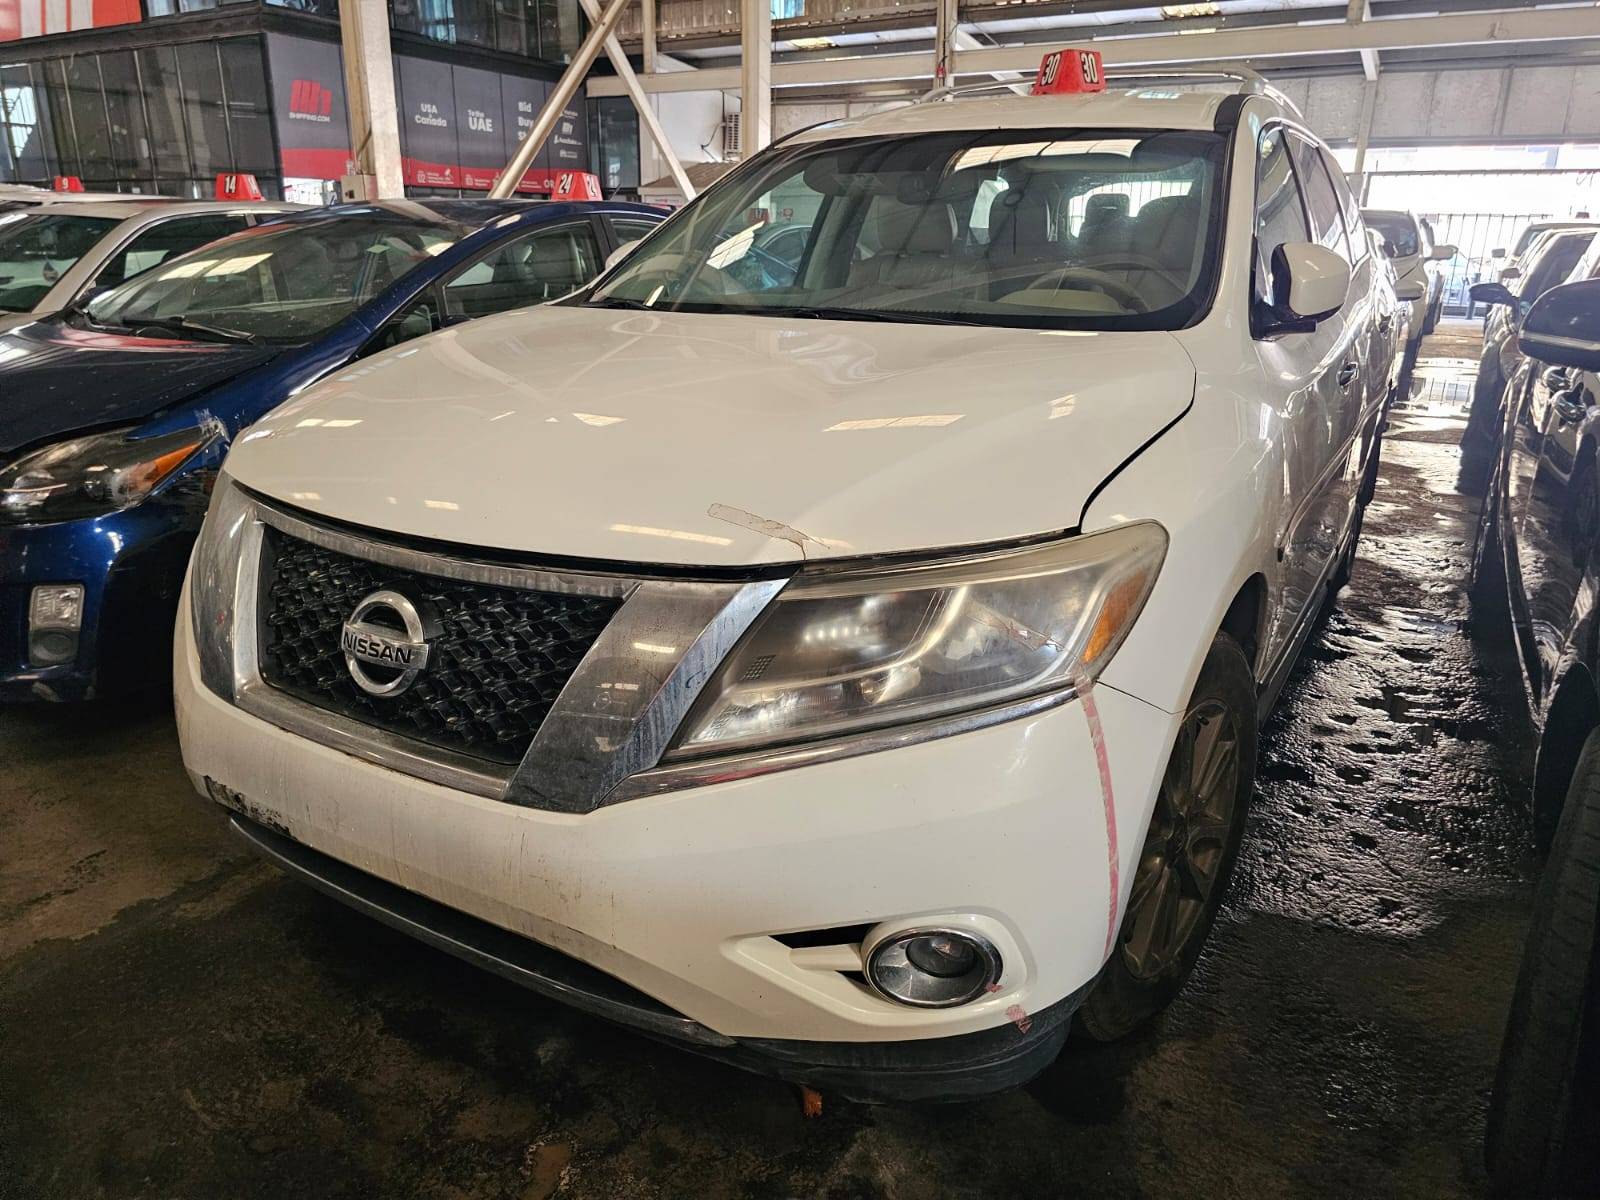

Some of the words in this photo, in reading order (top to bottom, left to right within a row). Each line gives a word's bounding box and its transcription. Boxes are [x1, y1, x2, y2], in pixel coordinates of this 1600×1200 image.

[1041, 54, 1061, 86] 30
[1081, 53, 1098, 83] 30
[420, 103, 438, 114] USA
[415, 114, 448, 127] Canada
[468, 117, 493, 132] UAE
[225, 175, 236, 193] 14
[558, 173, 574, 194] 24
[343, 632, 412, 664] NISSAN
